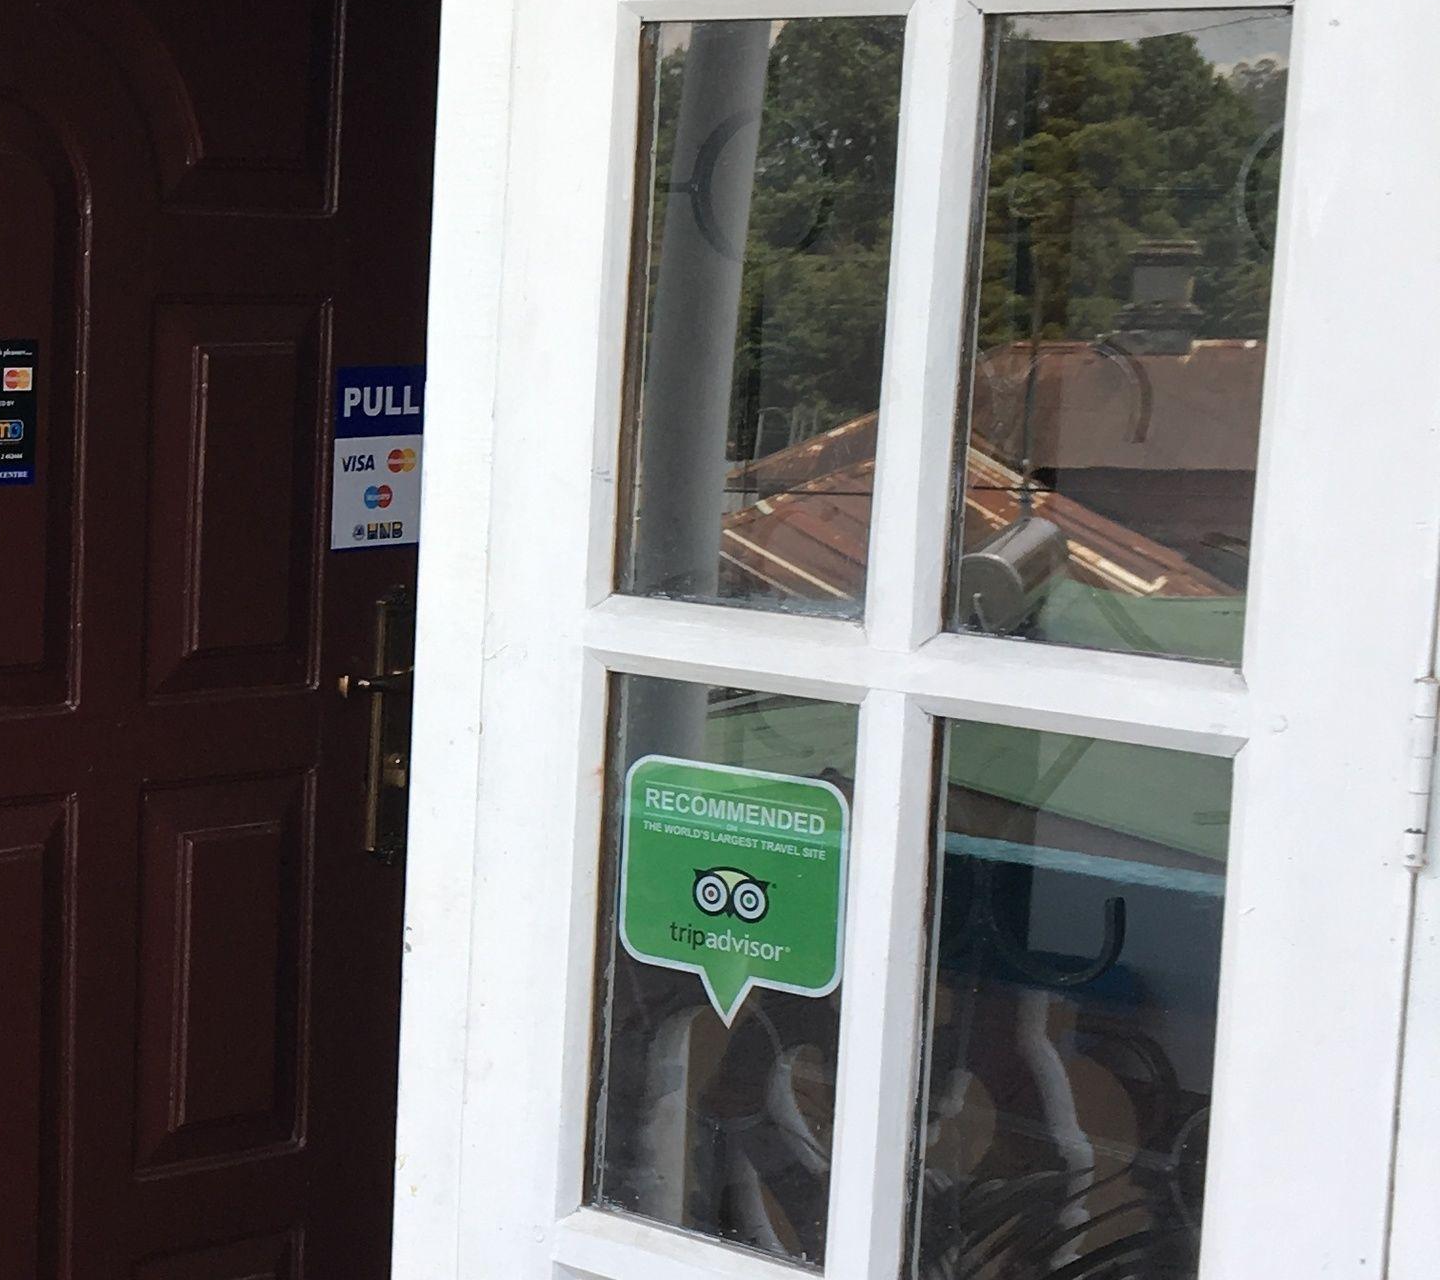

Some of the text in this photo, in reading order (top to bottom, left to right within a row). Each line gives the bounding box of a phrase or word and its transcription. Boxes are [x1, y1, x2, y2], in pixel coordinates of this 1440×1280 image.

[343, 385, 420, 417] PULL
[342, 454, 375, 472] VISA
[367, 522, 403, 539] HNB
[645, 787, 826, 835] RECOMMENDED
[643, 820, 662, 832] THE
[710, 831, 759, 849] LARGEST
[760, 840, 801, 856] TRAVEL
[802, 847, 827, 861] SITE
